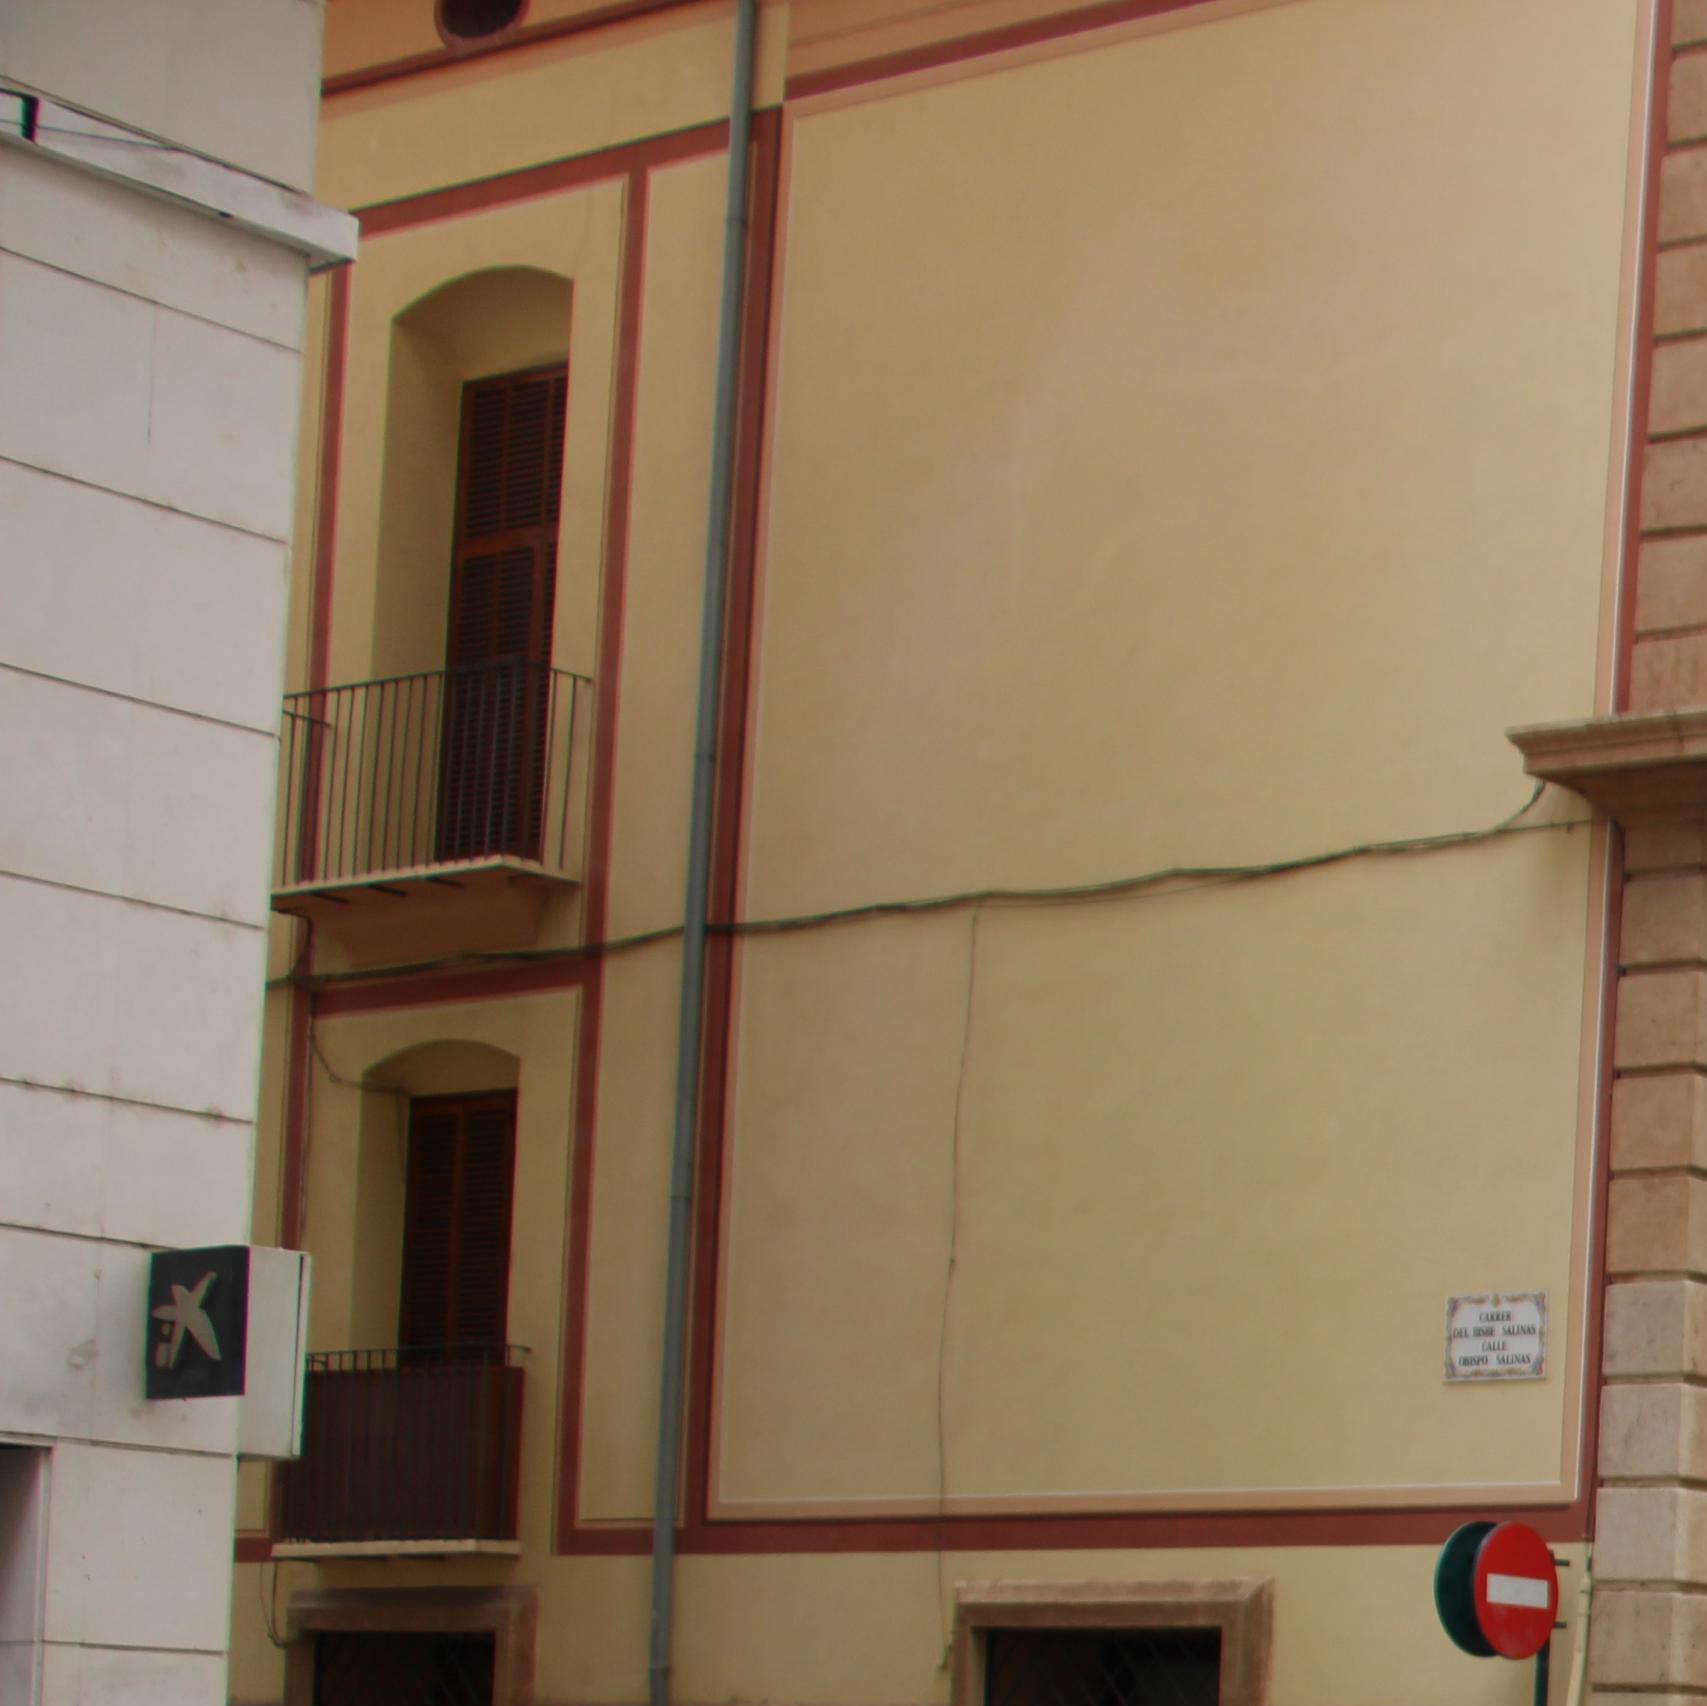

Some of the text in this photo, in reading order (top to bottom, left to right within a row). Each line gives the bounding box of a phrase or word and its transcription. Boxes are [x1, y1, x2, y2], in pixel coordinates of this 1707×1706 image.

[1479, 1311, 1512, 1322] CARRER
[1453, 1324, 1537, 1338] DEL BISBE SALINAS
[1481, 1340, 1506, 1351] CALLE
[1459, 1353, 1531, 1366] OBISPO SALINAS
